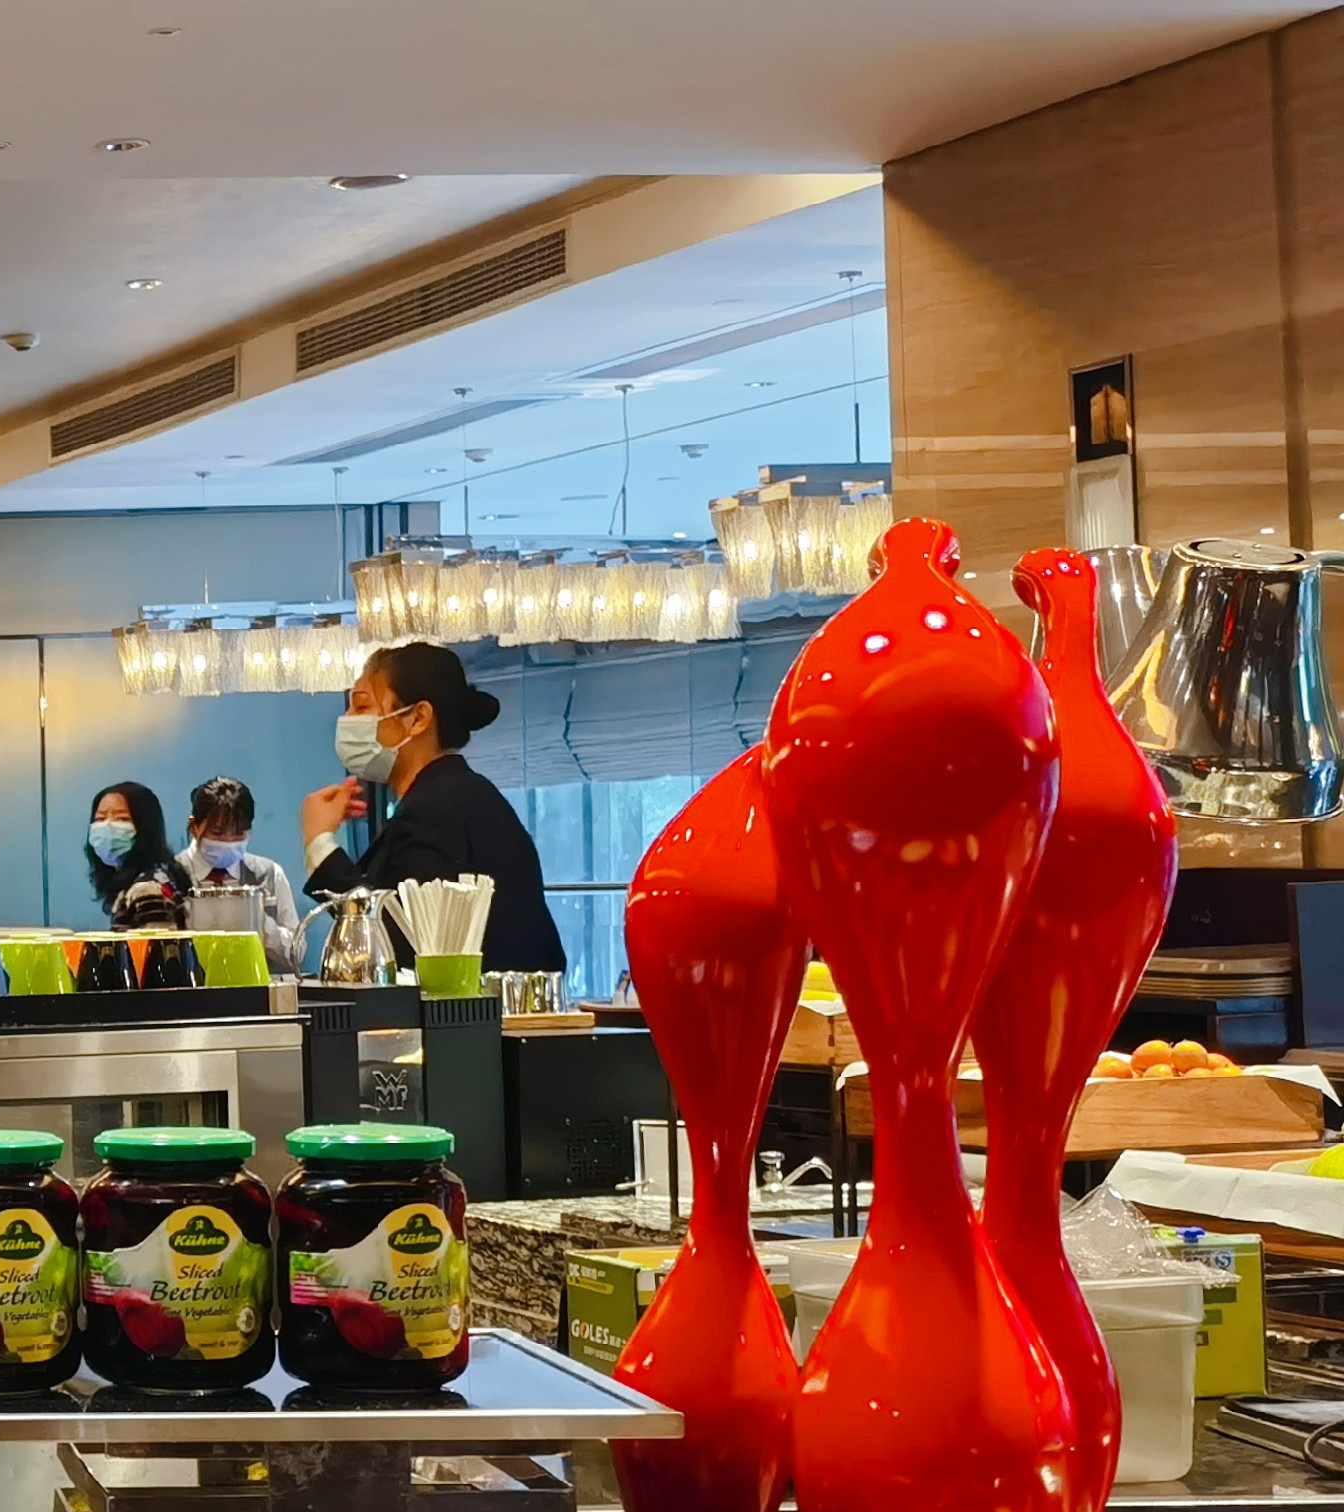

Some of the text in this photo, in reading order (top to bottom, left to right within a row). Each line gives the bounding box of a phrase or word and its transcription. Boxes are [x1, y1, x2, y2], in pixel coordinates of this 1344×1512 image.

[177, 1262, 223, 1280] Sliced
[397, 1260, 439, 1279] Sliced
[150, 1280, 241, 1301] Beetroot
